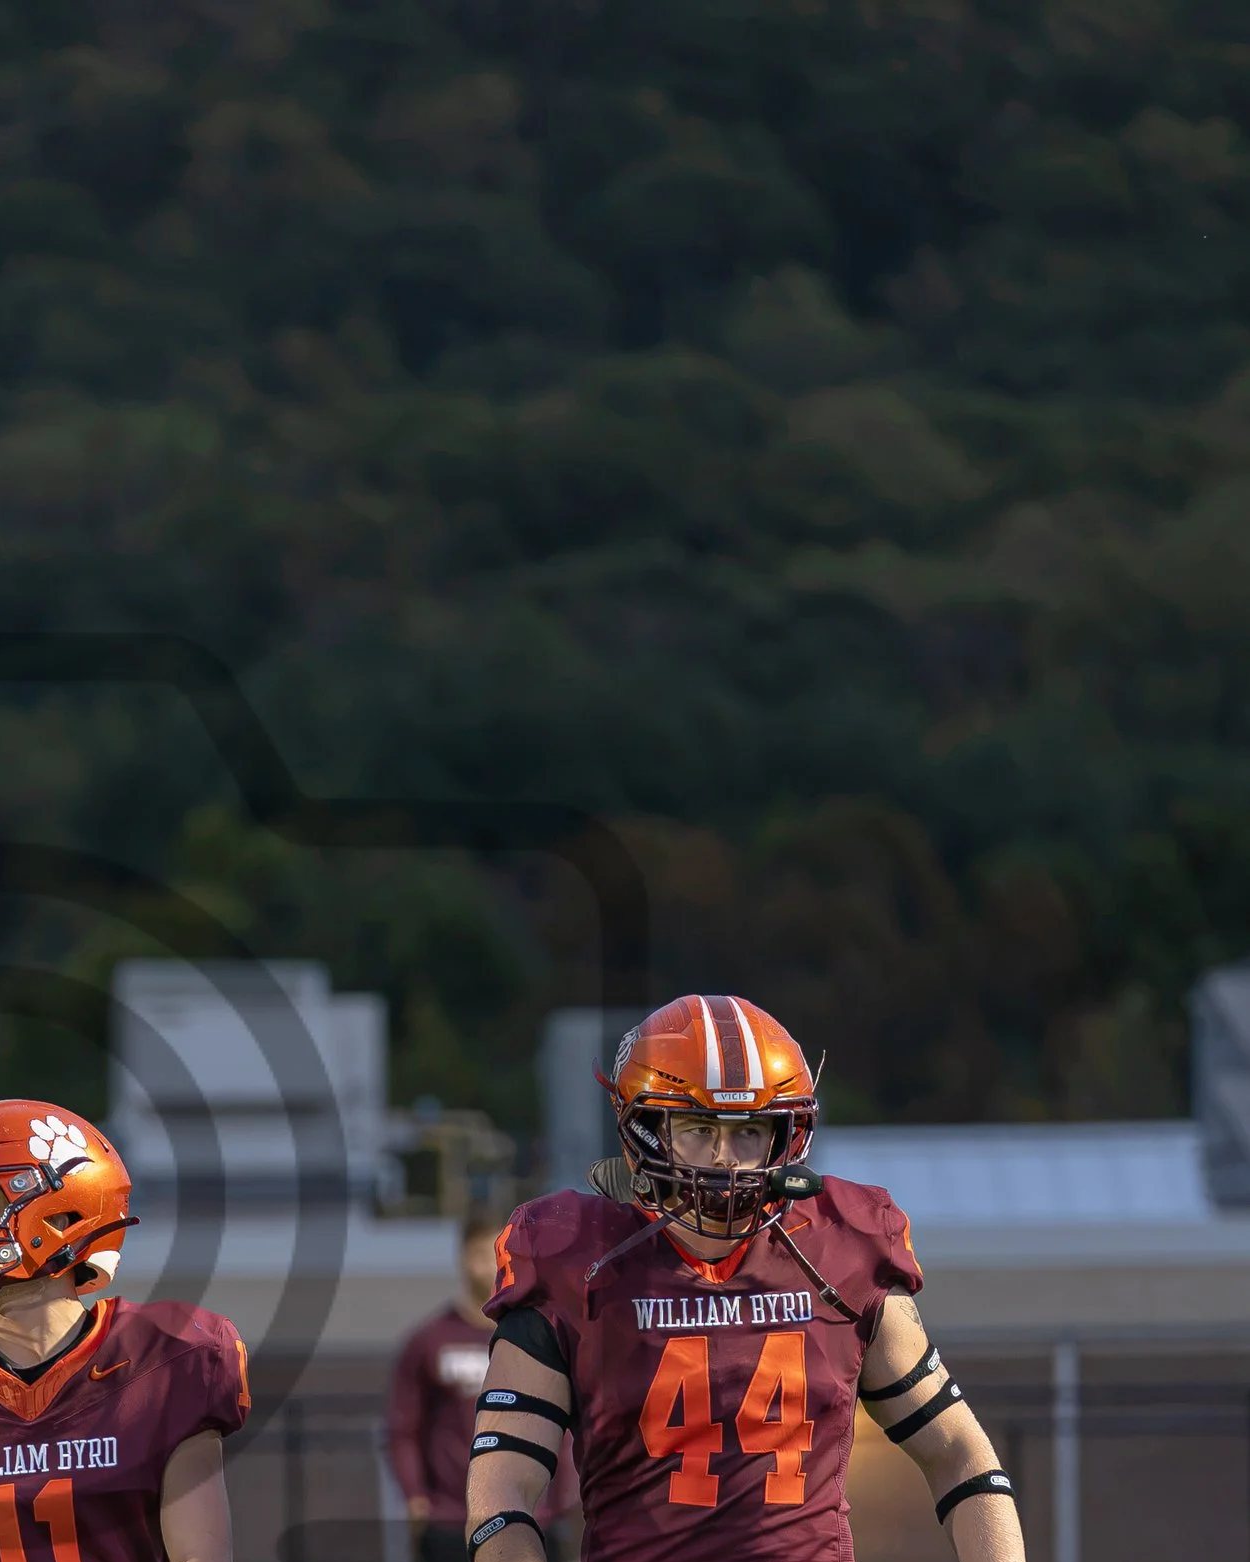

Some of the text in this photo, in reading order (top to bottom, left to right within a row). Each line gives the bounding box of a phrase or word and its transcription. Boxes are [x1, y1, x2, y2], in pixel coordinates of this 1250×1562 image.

[720, 1092, 748, 1101] VICIS
[632, 1291, 813, 1330] WILLIAM BYRD
[638, 1330, 815, 1508] 44
[56, 1436, 118, 1470] BYRD
[475, 1519, 503, 1542] BATTLE
